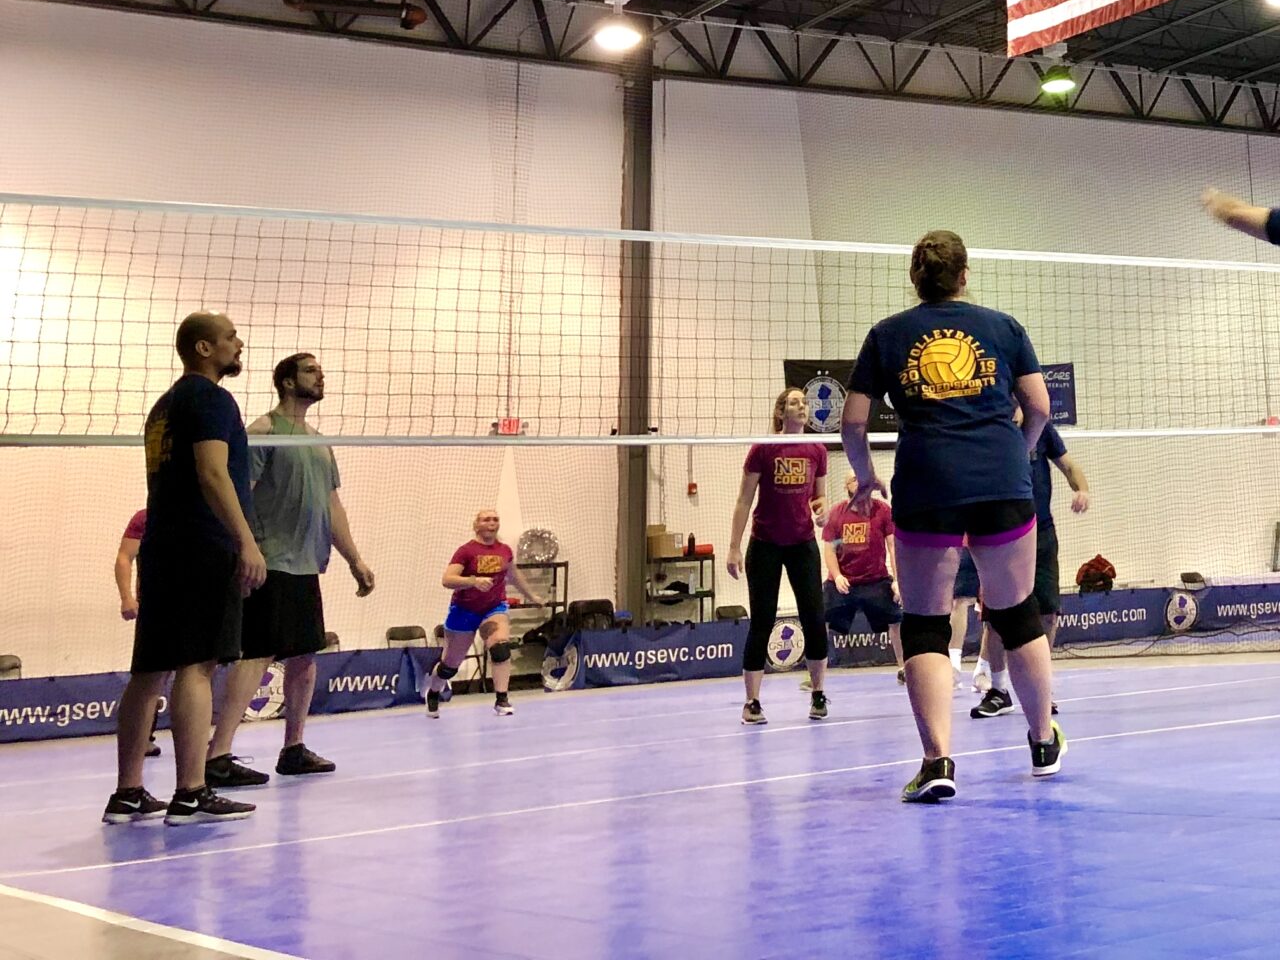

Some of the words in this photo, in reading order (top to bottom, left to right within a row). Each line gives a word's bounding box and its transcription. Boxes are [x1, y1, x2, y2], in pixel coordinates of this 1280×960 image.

[907, 328, 986, 368] VOLLEYBALL
[980, 360, 996, 373] 19
[774, 457, 806, 476] NJ
[774, 475, 806, 485] COED
[1056, 607, 1147, 629] ww.gsevc.com
